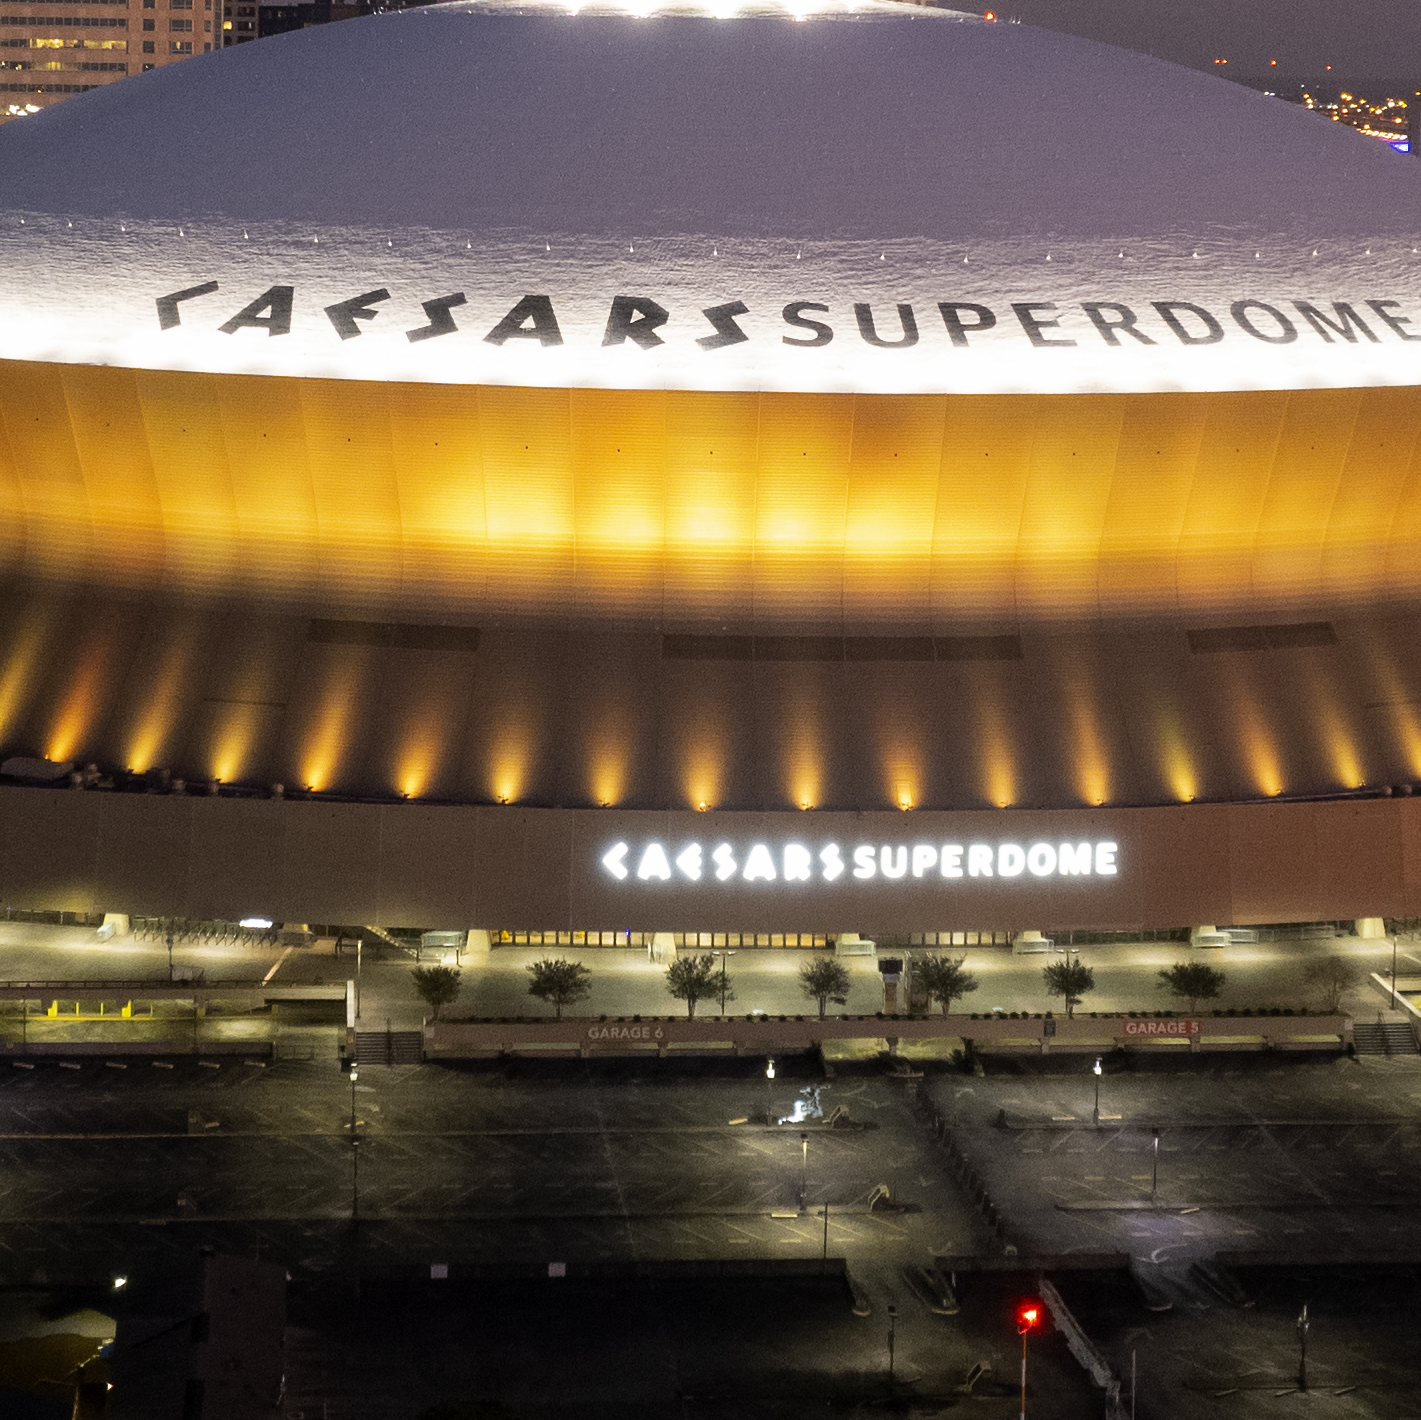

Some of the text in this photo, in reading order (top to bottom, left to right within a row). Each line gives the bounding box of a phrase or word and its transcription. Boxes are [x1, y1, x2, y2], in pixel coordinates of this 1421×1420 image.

[155, 280, 751, 352] CAESARS
[601, 841, 1118, 881] CAESARS SUPERDOME
[588, 1026, 664, 1040] GARAGE 6
[1126, 1022, 1199, 1035] GARAGE 5
